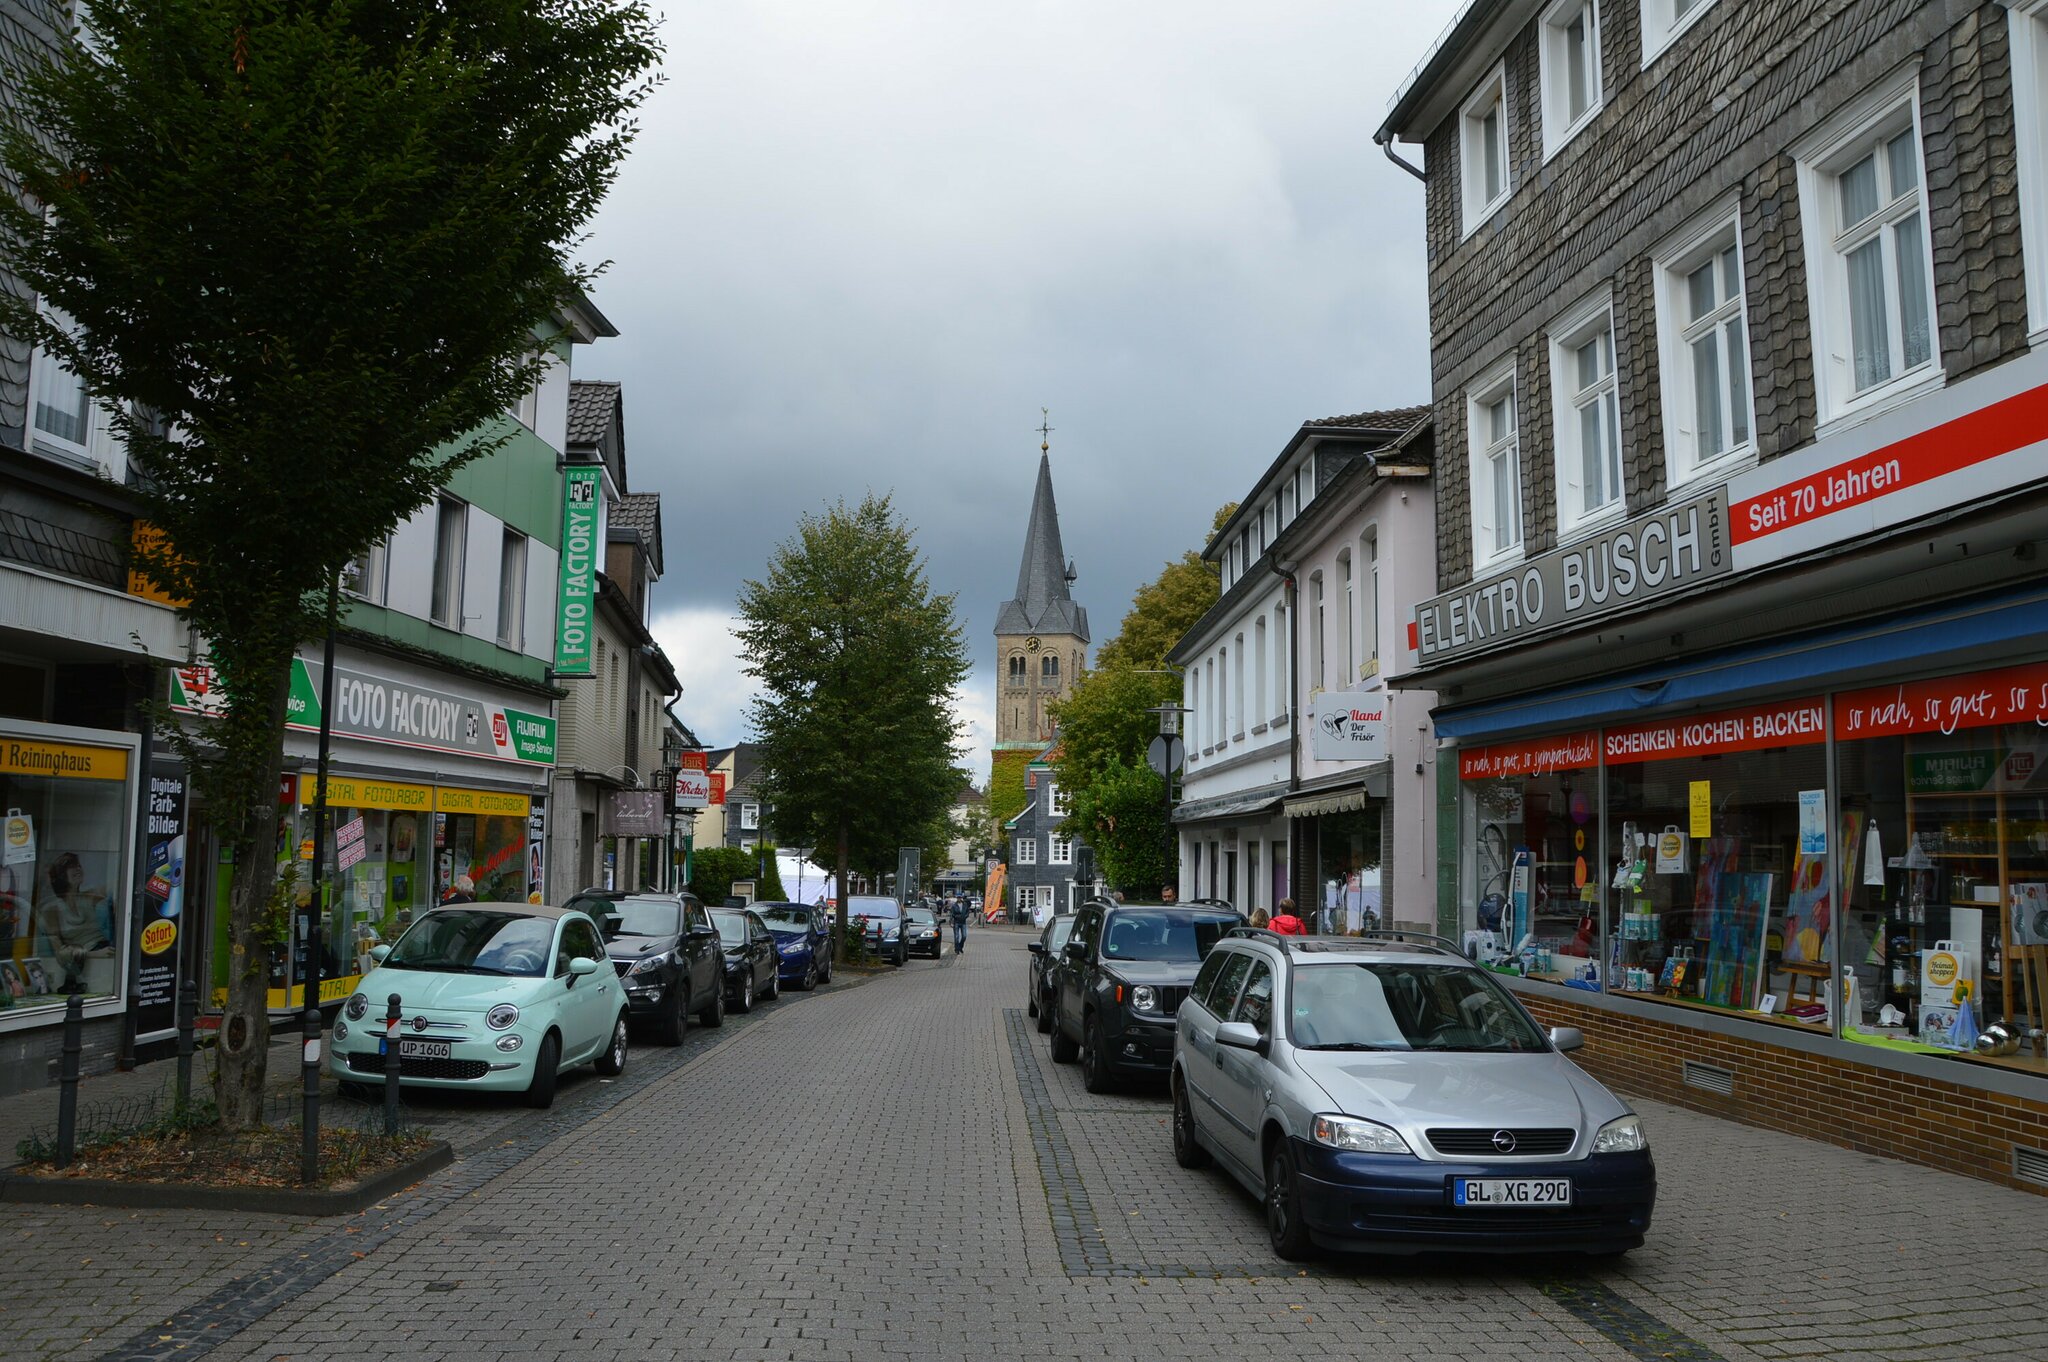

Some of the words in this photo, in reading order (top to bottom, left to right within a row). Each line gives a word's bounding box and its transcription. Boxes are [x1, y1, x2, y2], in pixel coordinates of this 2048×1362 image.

[1749, 496, 1787, 532] Seit
[1791, 485, 1815, 517] 70
[1821, 459, 1901, 508] Jahren
[568, 502, 594, 510] FACTORY
[1707, 496, 1721, 567] GmbH
[566, 511, 591, 597] FACTORY
[1419, 566, 1545, 656] ELEKTRO
[1561, 505, 1701, 613] BUSCH
[563, 603, 585, 654] FOTO
[287, 695, 306, 712] vice
[337, 677, 387, 730] FOTO
[390, 689, 461, 742] FACTORY
[1847, 708, 1864, 731] so
[1870, 684, 1914, 728] nah,
[1923, 698, 1942, 722] so
[1940, 689, 1996, 735] gut,
[2007, 687, 2029, 713] so
[516, 719, 546, 739] FUJIFILM
[1350, 722, 1366, 731] Der
[1350, 732, 1375, 741] Frisör
[1606, 728, 1676, 756] SCHENKEN
[1682, 718, 1744, 747] KOCHEN
[1752, 707, 1823, 739] BACKEN
[521, 739, 536, 754] Image
[535, 742, 553, 755] Service
[9, 744, 92, 775] Reininghaus
[150, 777, 183, 796] Digitale
[364, 785, 425, 805] FOTOLABOR
[149, 794, 177, 813] Farb-
[442, 792, 474, 808] DIGITAL
[479, 796, 524, 811] FOTOLABOR
[148, 815, 180, 834] Bilder
[145, 923, 172, 945] Sofort
[1929, 967, 1955, 977] shoppen
[1931, 961, 1954, 969] Heimat
[402, 1042, 417, 1054] UP
[419, 1043, 448, 1056] 1606
[1466, 1182, 1490, 1201] GL
[1504, 1182, 1529, 1201] XG
[1533, 1182, 1567, 1202] 290
